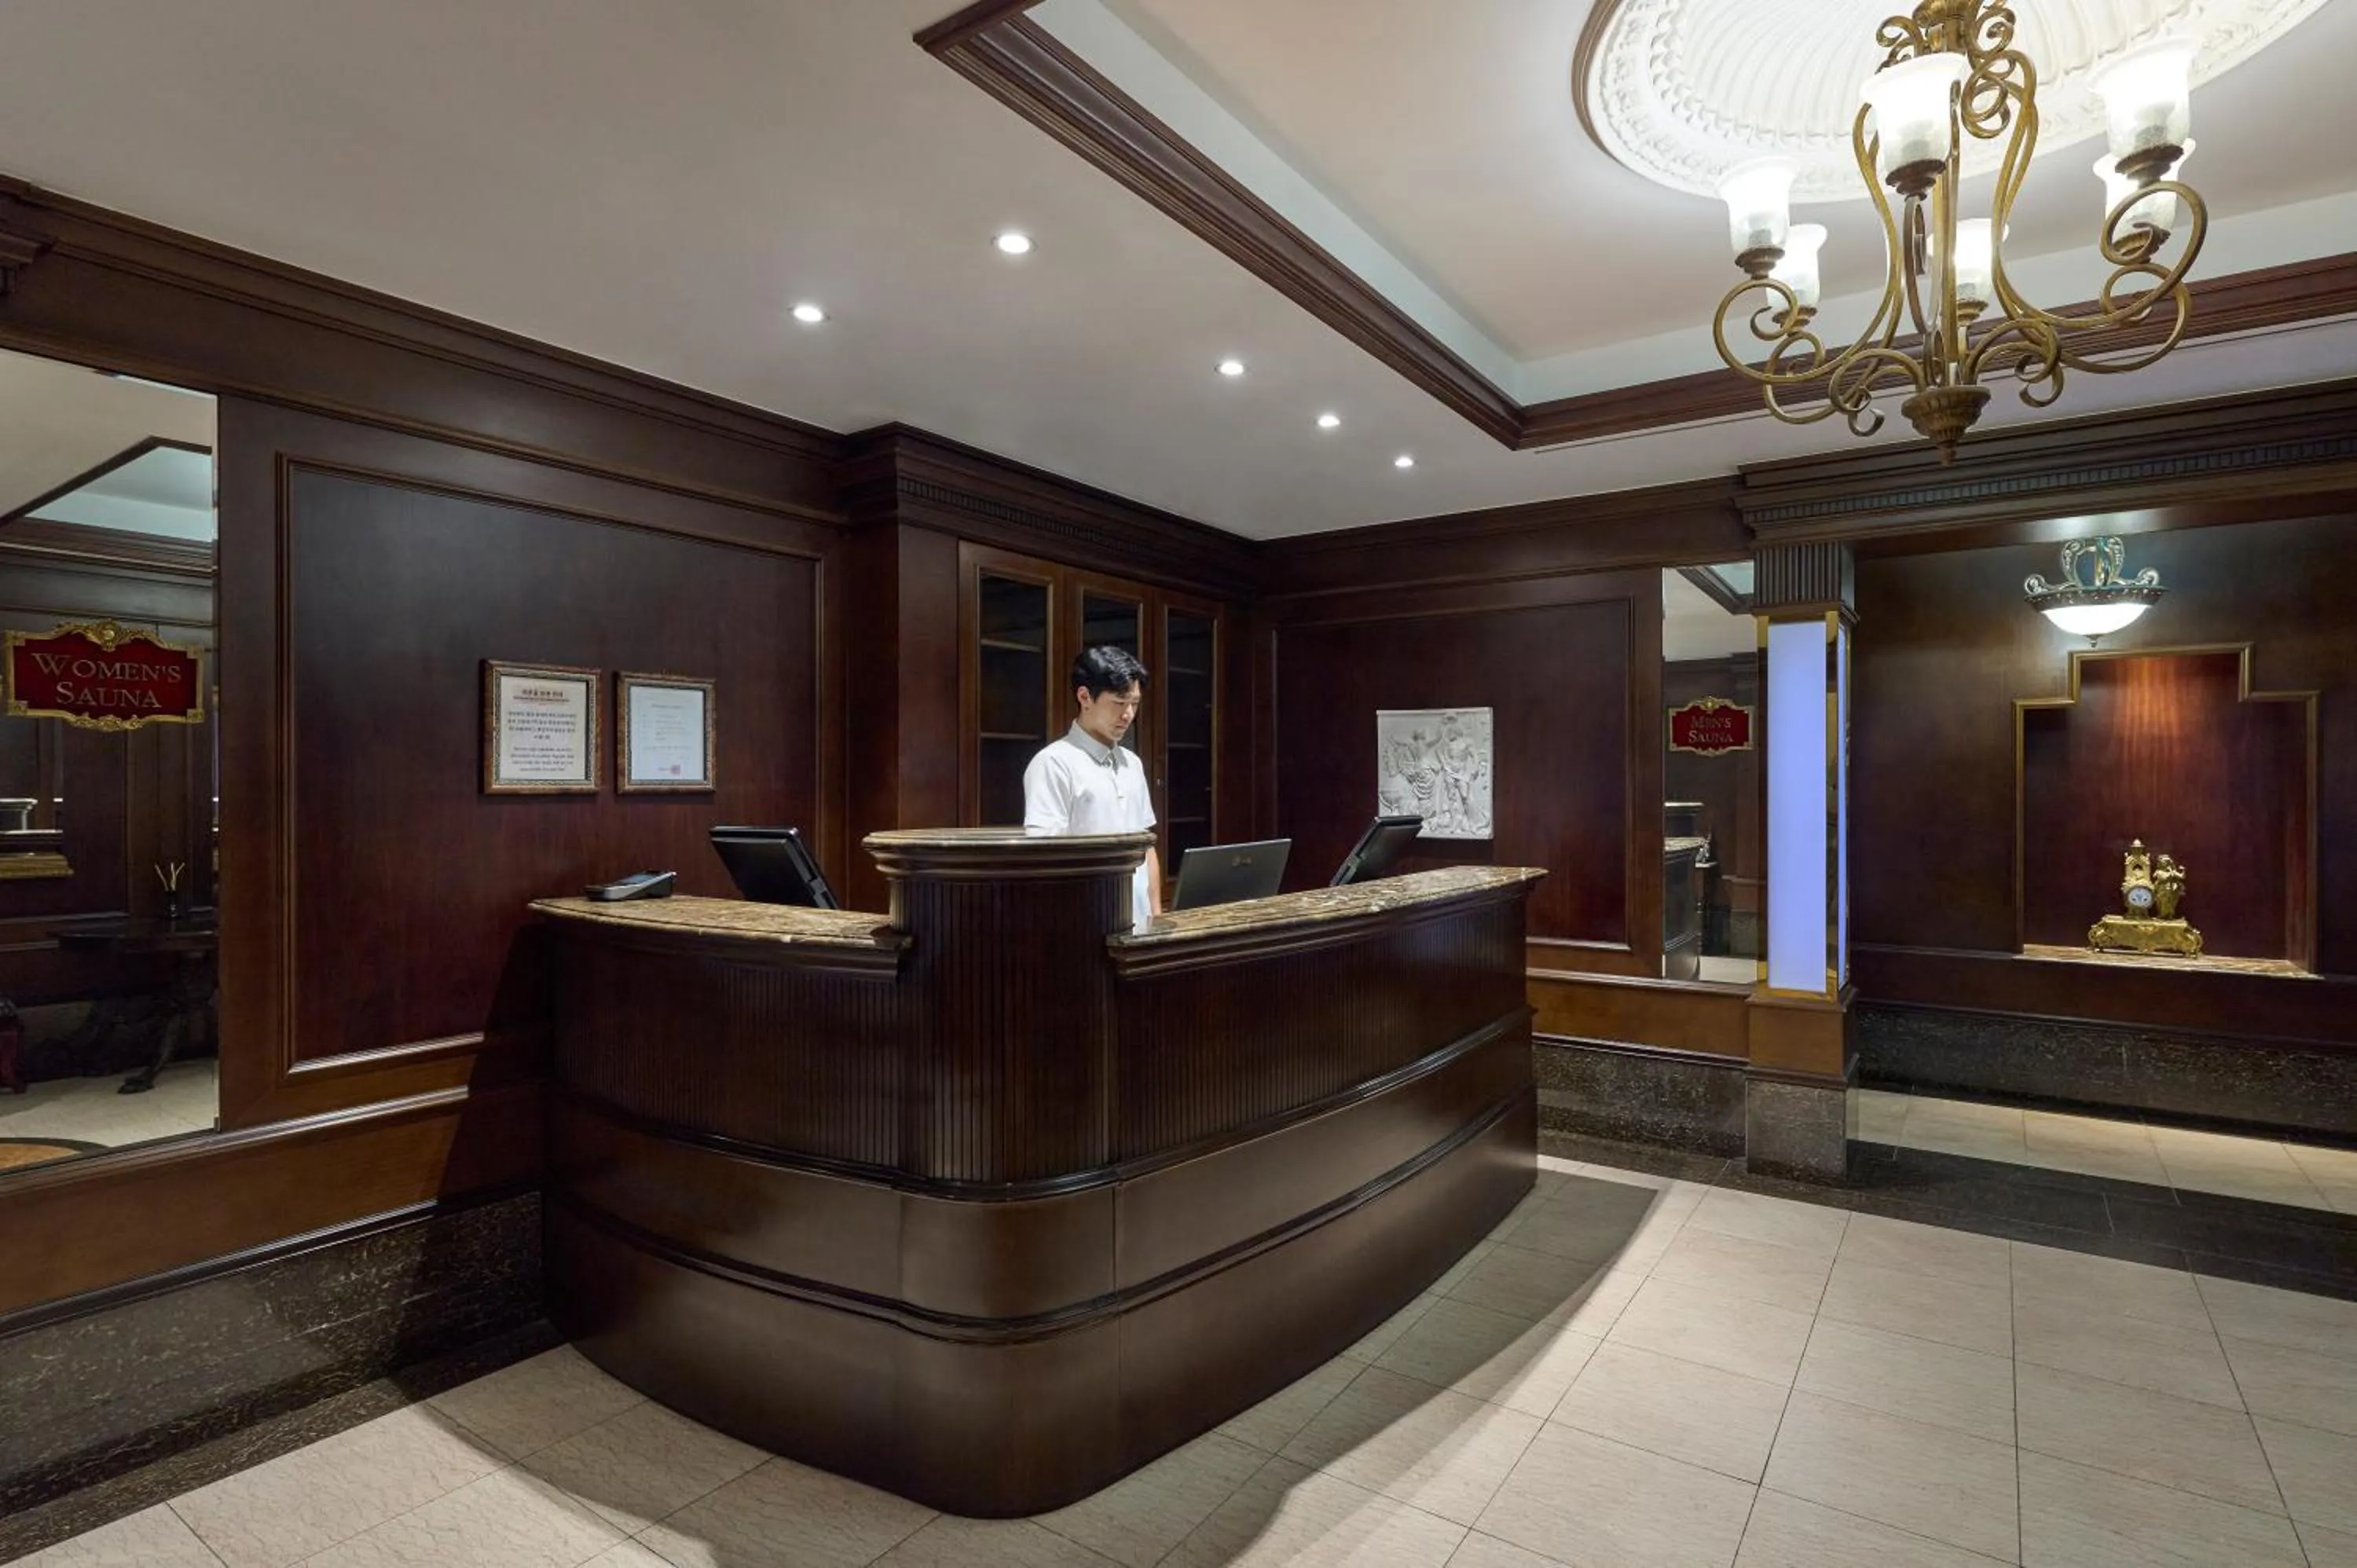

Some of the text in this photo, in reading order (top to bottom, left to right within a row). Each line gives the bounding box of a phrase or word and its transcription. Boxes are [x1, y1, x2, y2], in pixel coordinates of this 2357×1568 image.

[31, 653, 181, 683] WOMEN'S
[55, 681, 163, 708] SAUNA
[1688, 730, 1734, 743] SAUNA
